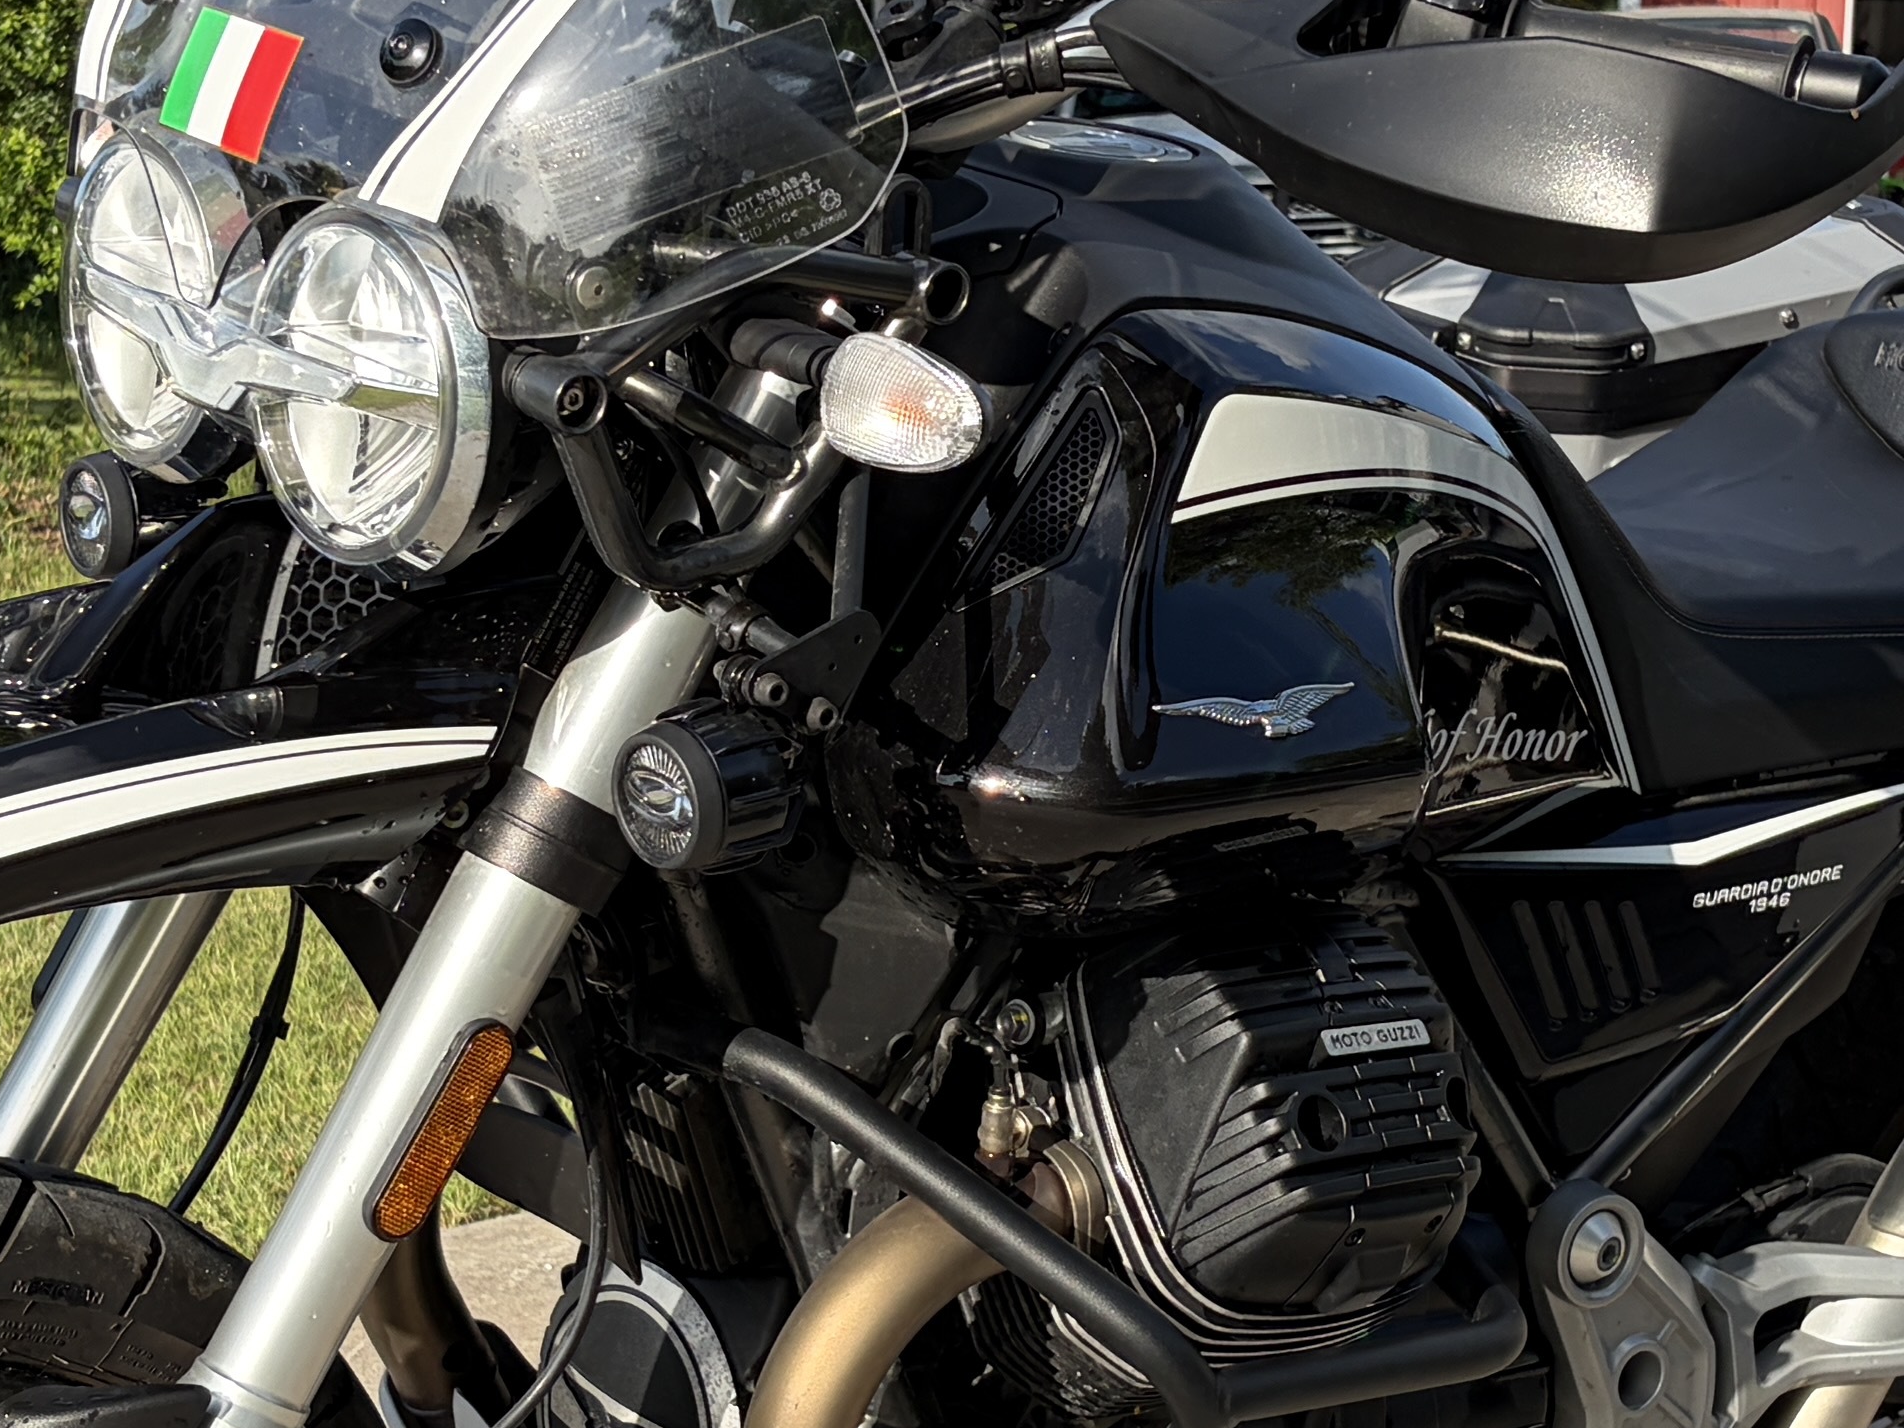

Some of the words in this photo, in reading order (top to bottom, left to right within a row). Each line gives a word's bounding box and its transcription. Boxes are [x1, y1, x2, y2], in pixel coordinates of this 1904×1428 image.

[1466, 711, 1588, 762] Honor
[1692, 880, 1769, 908] GUARDIA
[1770, 864, 1844, 893] D'ONORE
[1749, 892, 1791, 913] 1946
[1330, 1030, 1373, 1049] MOTO
[1376, 1025, 1421, 1043] GUZZI
